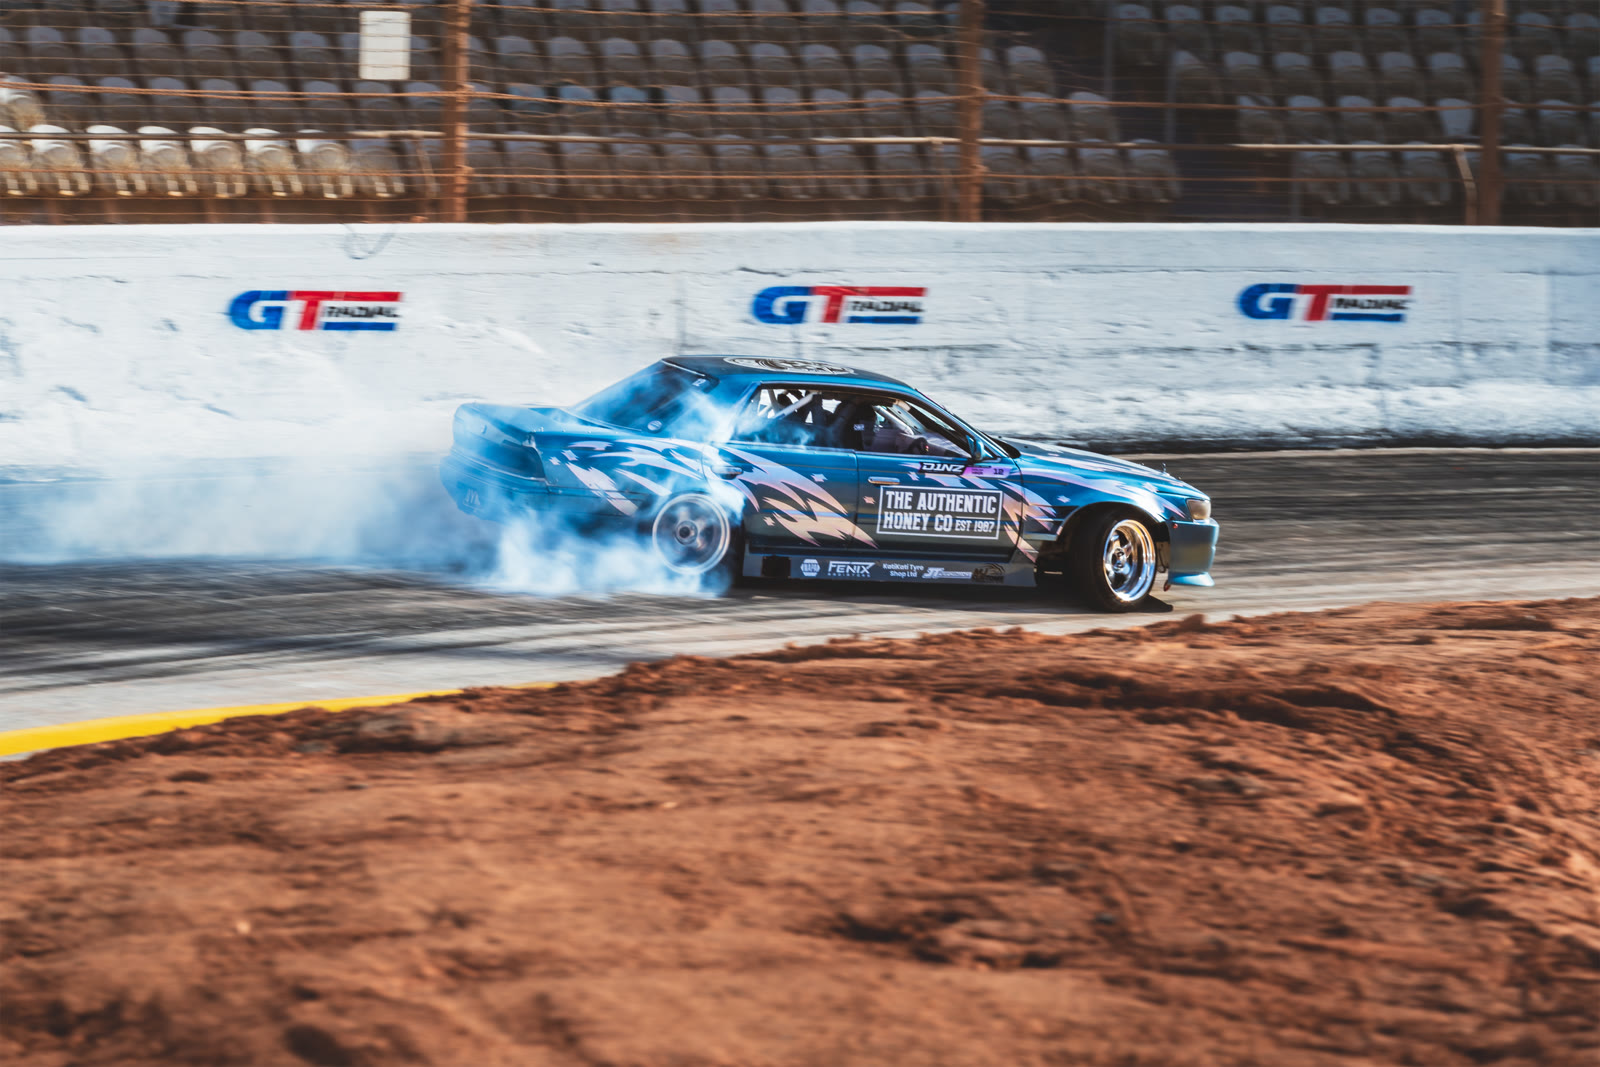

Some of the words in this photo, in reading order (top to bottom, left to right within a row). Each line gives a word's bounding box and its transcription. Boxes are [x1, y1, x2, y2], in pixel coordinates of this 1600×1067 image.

[229, 290, 402, 330] GT
[753, 286, 926, 324] GT
[1237, 283, 1411, 321] GT
[922, 462, 965, 473] D1NZ
[885, 491, 913, 510] THE
[916, 493, 997, 514] AUTHENTIC
[882, 511, 931, 531] HONEY
[934, 513, 953, 532] CO
[954, 519, 972, 532] EST
[974, 520, 995, 533] 1987
[828, 560, 875, 574] FENIX
[889, 570, 907, 578] Shop
[909, 564, 924, 572] Tyre
